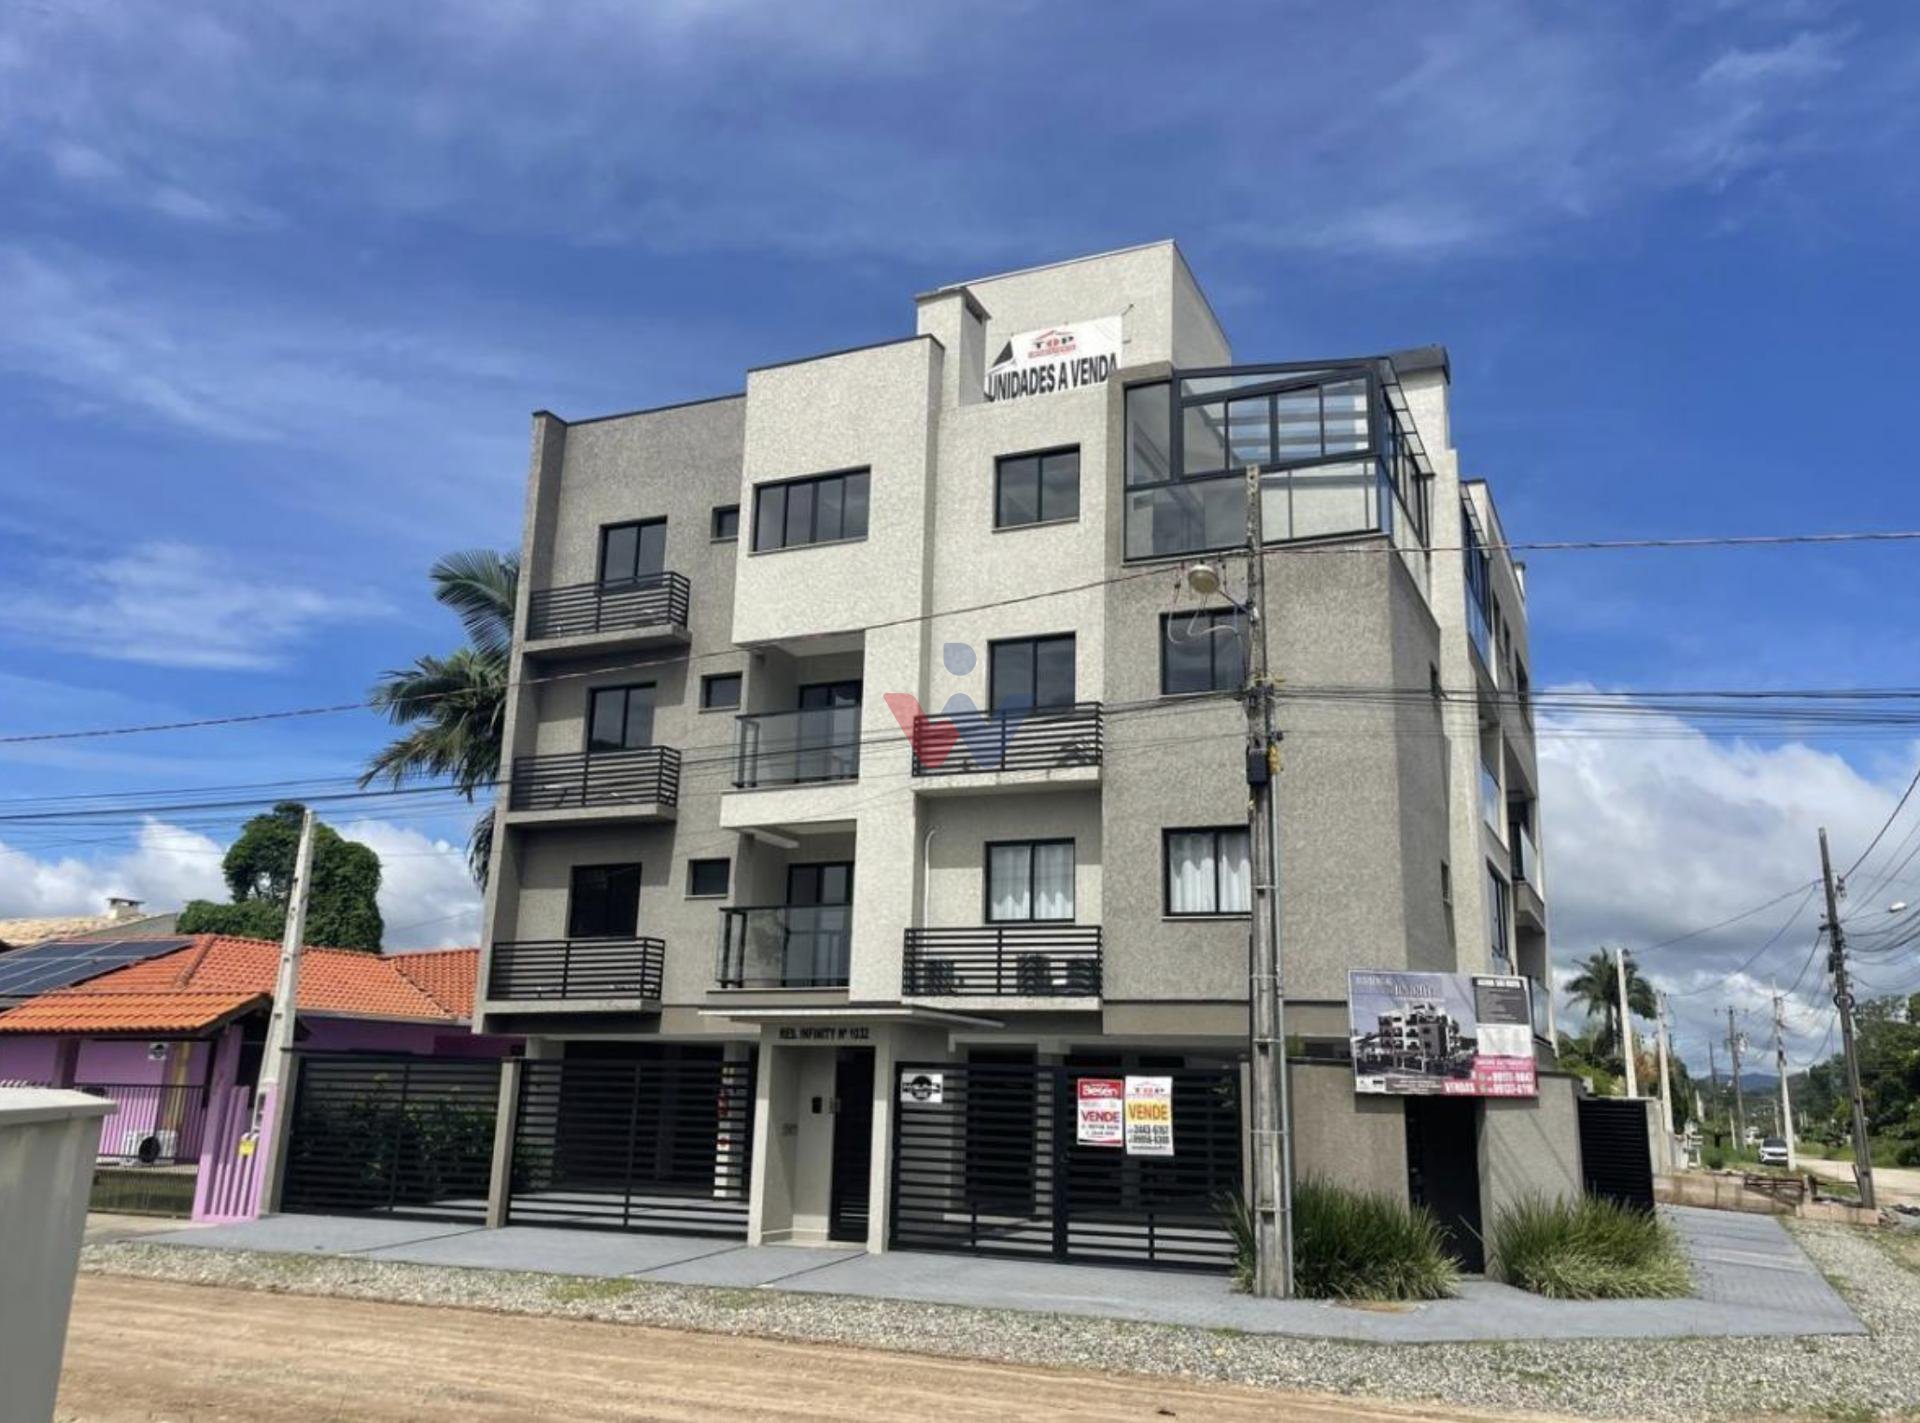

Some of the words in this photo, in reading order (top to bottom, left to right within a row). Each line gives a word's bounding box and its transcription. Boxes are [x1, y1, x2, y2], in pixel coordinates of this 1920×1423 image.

[984, 362, 1055, 402] UNIDADES
[1058, 362, 1068, 391] A
[1071, 353, 1117, 388] VENDA
[1081, 1110, 1121, 1123] VENDE
[1128, 1103, 1168, 1121] VENDE
